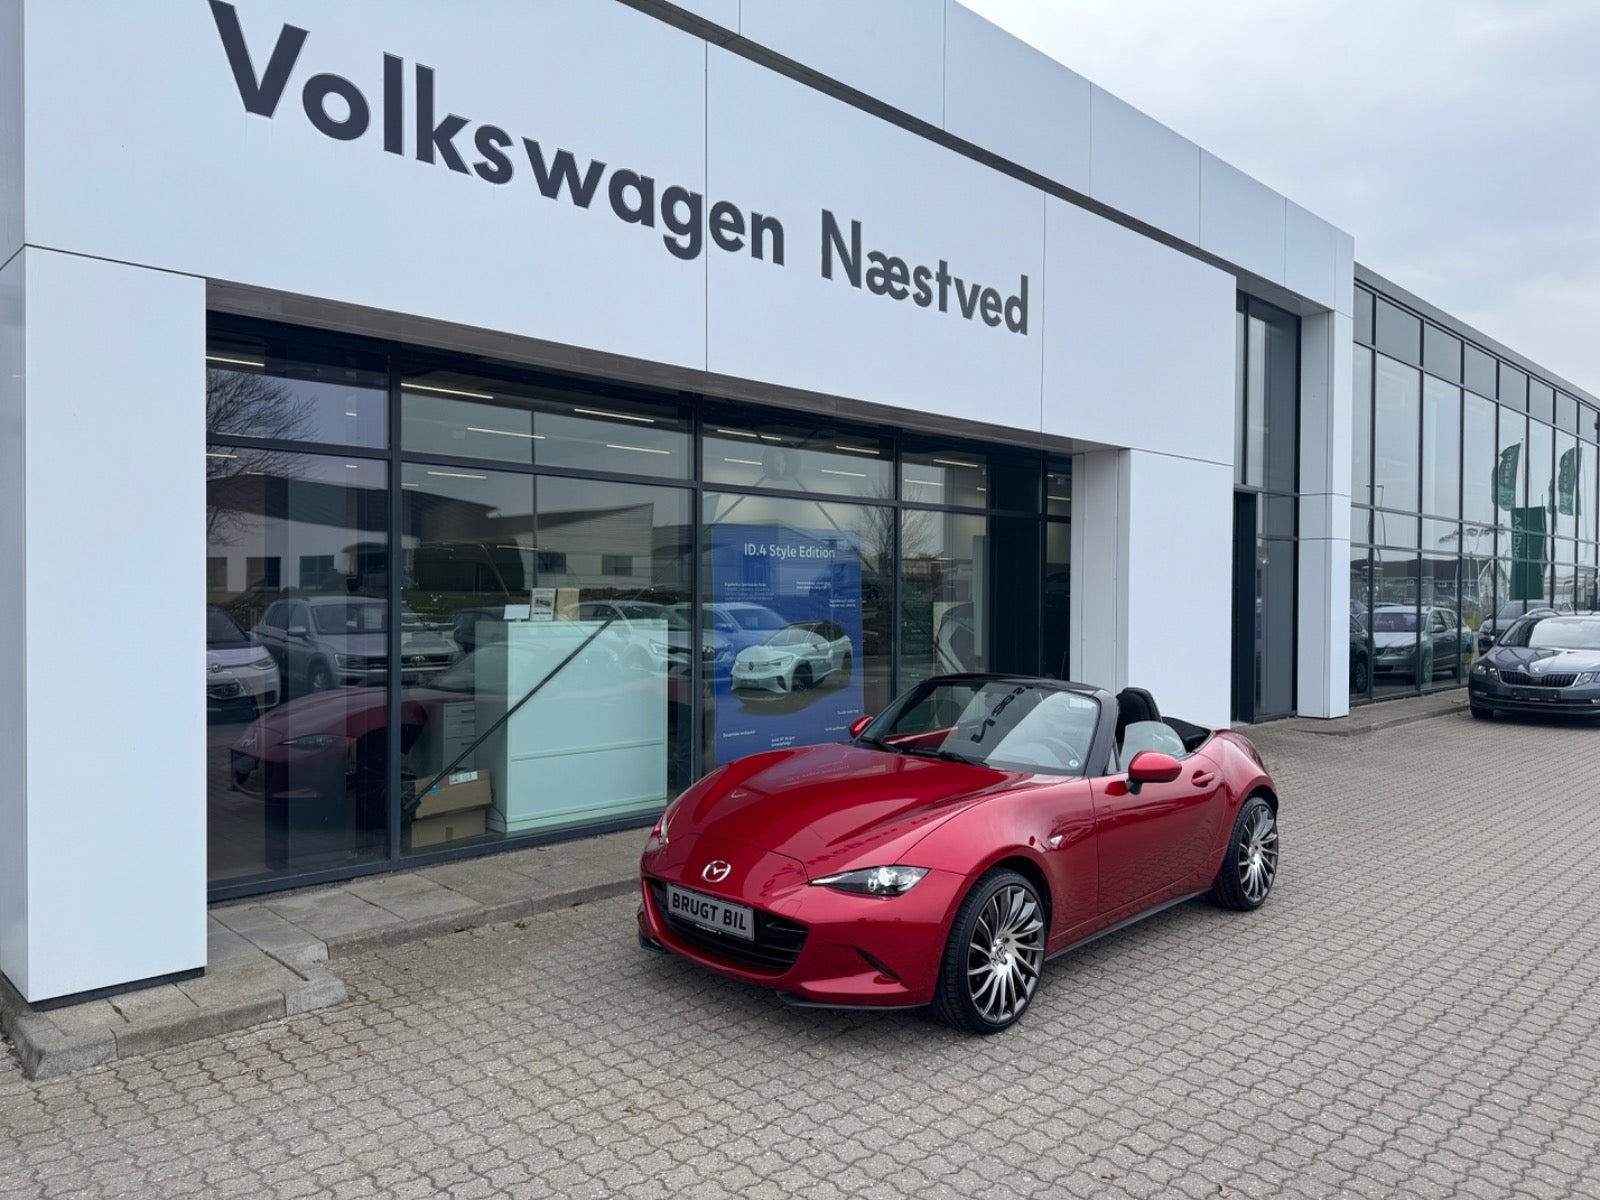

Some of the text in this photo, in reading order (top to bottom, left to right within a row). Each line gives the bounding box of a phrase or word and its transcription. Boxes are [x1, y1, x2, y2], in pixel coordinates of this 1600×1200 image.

[210, 0, 1030, 336] Volkswagen Næstved
[744, 543, 836, 560] ID.4 Style Edition
[672, 892, 747, 931] BRUGT BIL
